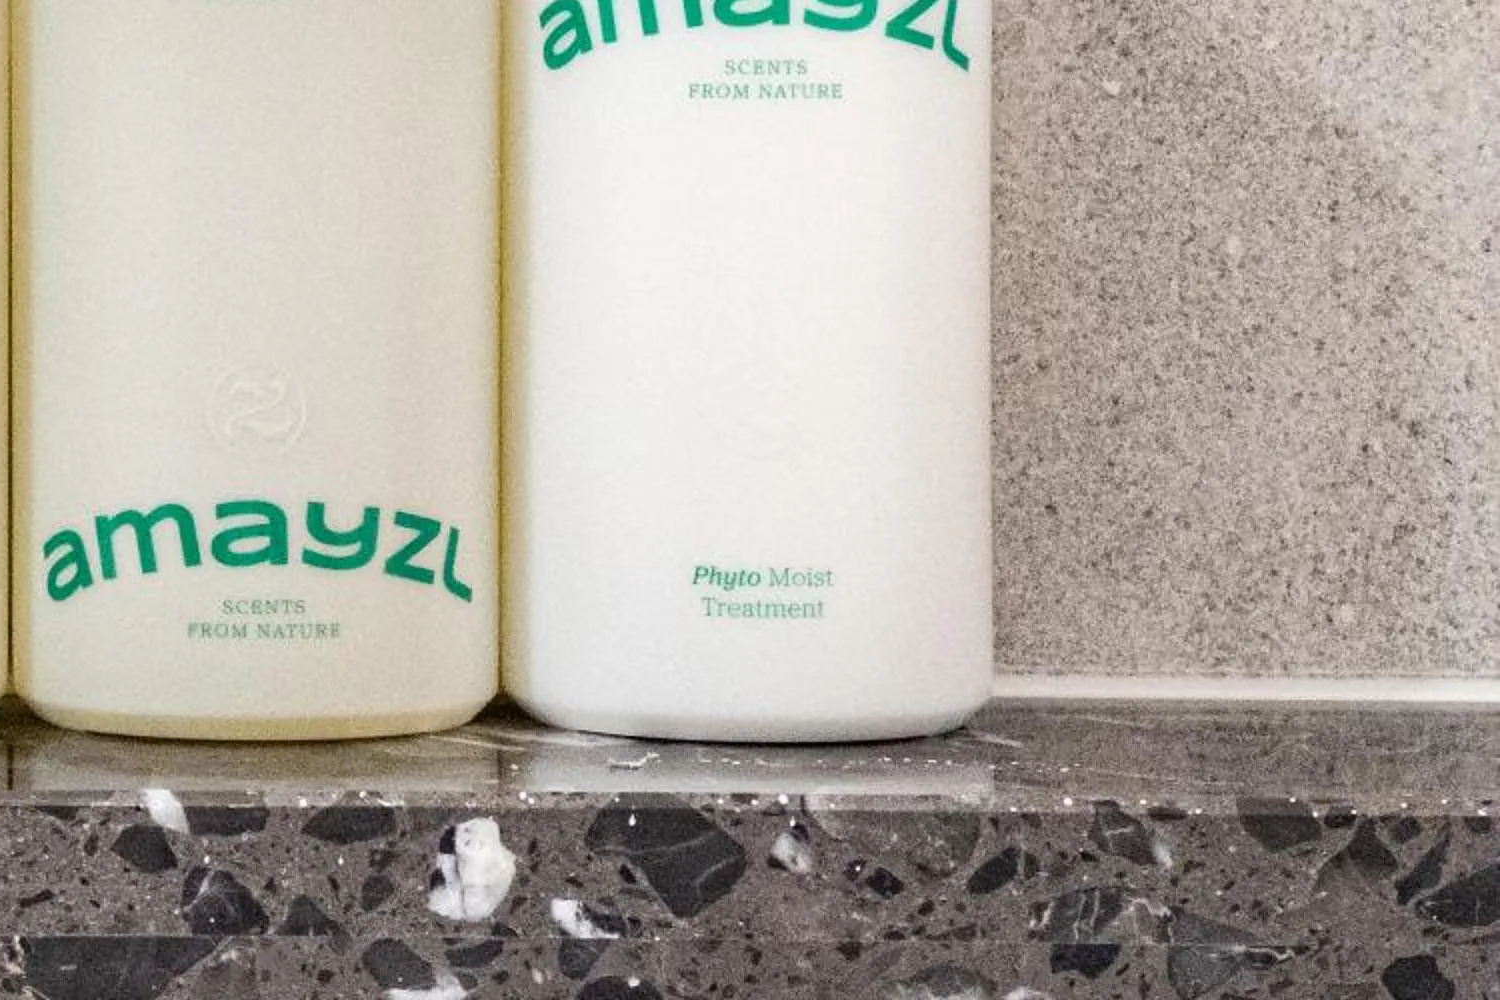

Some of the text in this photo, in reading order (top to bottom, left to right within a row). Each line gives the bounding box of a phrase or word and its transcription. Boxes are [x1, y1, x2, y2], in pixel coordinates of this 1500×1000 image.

[723, 59, 809, 78] SCENTS
[688, 83, 843, 100] FROM NATURE
[691, 564, 835, 591] Phyto Moist
[221, 599, 307, 616] SCENTS
[701, 596, 825, 619] Treatment
[187, 622, 342, 640] FROM NATURE
